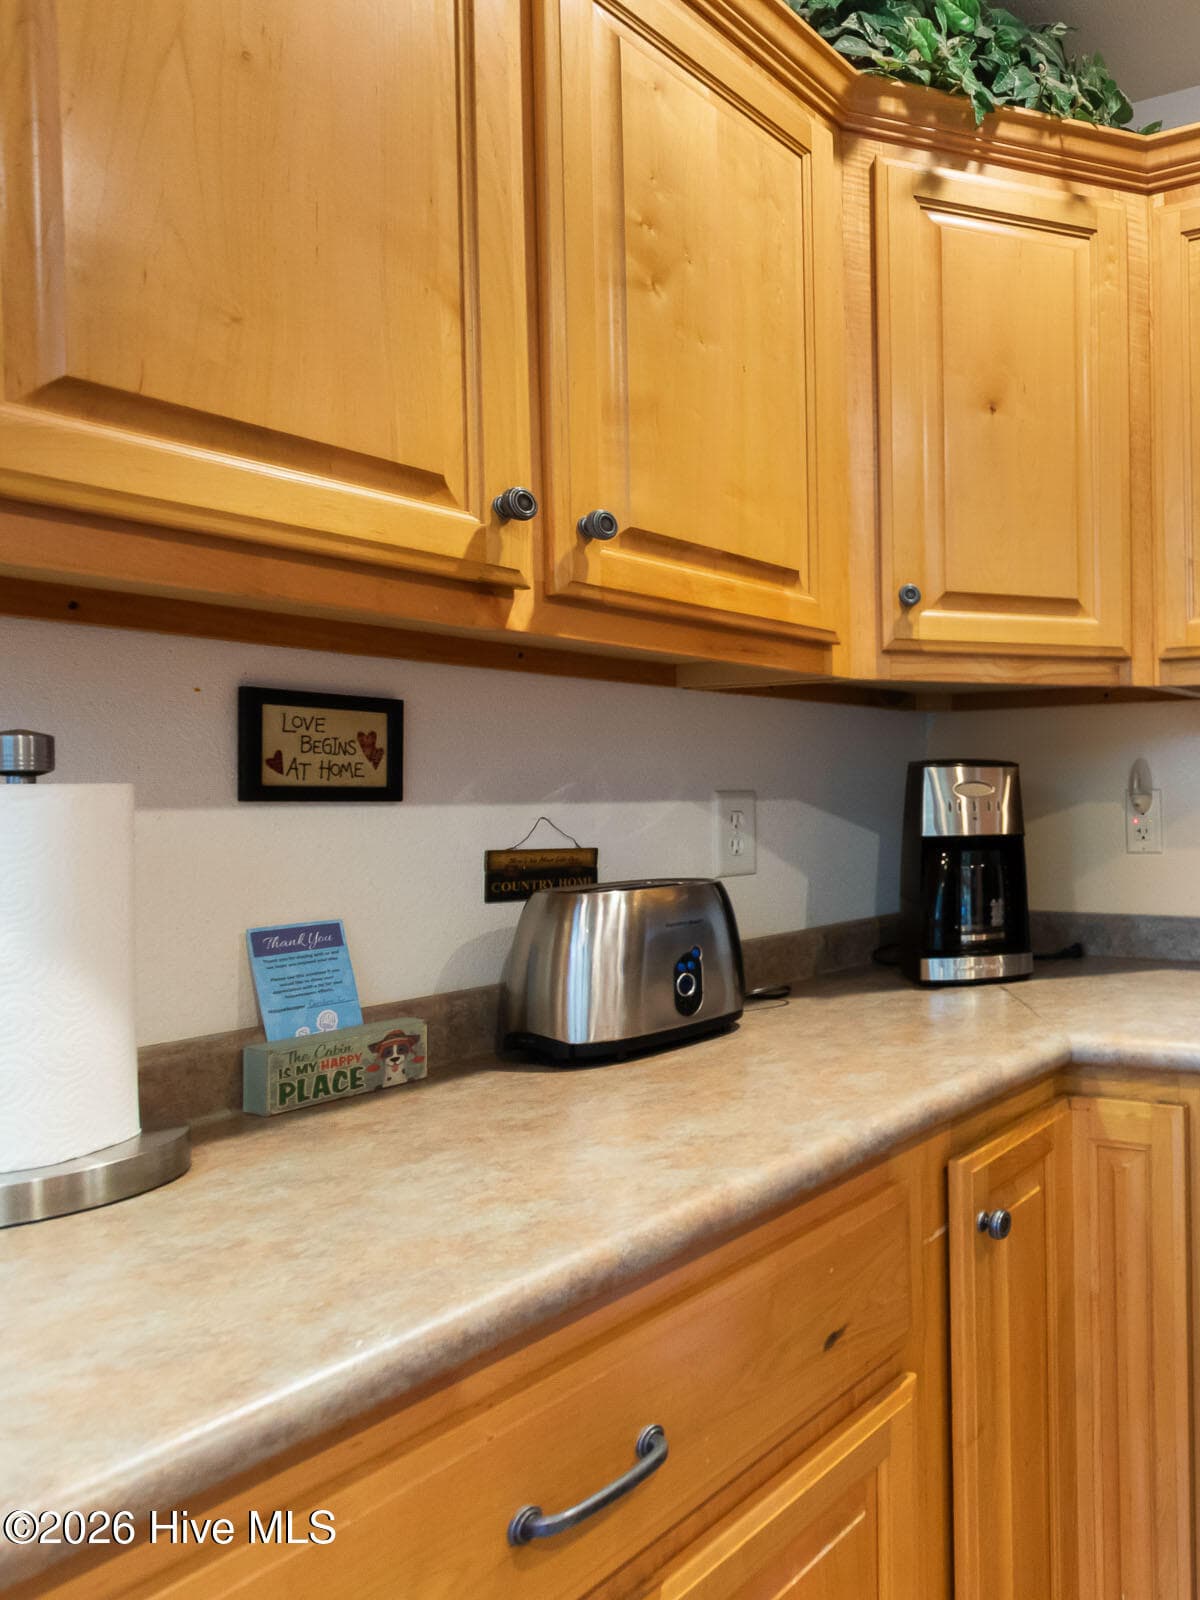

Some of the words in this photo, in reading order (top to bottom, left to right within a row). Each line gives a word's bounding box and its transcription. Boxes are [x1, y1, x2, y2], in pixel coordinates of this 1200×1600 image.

[281, 713, 326, 733] LOVE
[300, 735, 357, 756] BEGINS
[285, 757, 312, 781] AT
[319, 759, 366, 781] HOME
[490, 879, 554, 893] COUNTRY
[262, 934, 308, 950] Thank
[308, 931, 335, 950] You
[289, 1050, 310, 1065] The
[314, 1044, 353, 1061] Cabin
[278, 1067, 292, 1080] IS
[296, 1061, 318, 1076] MY
[320, 1052, 363, 1072] HAPPY
[278, 1065, 365, 1106] PLACE
